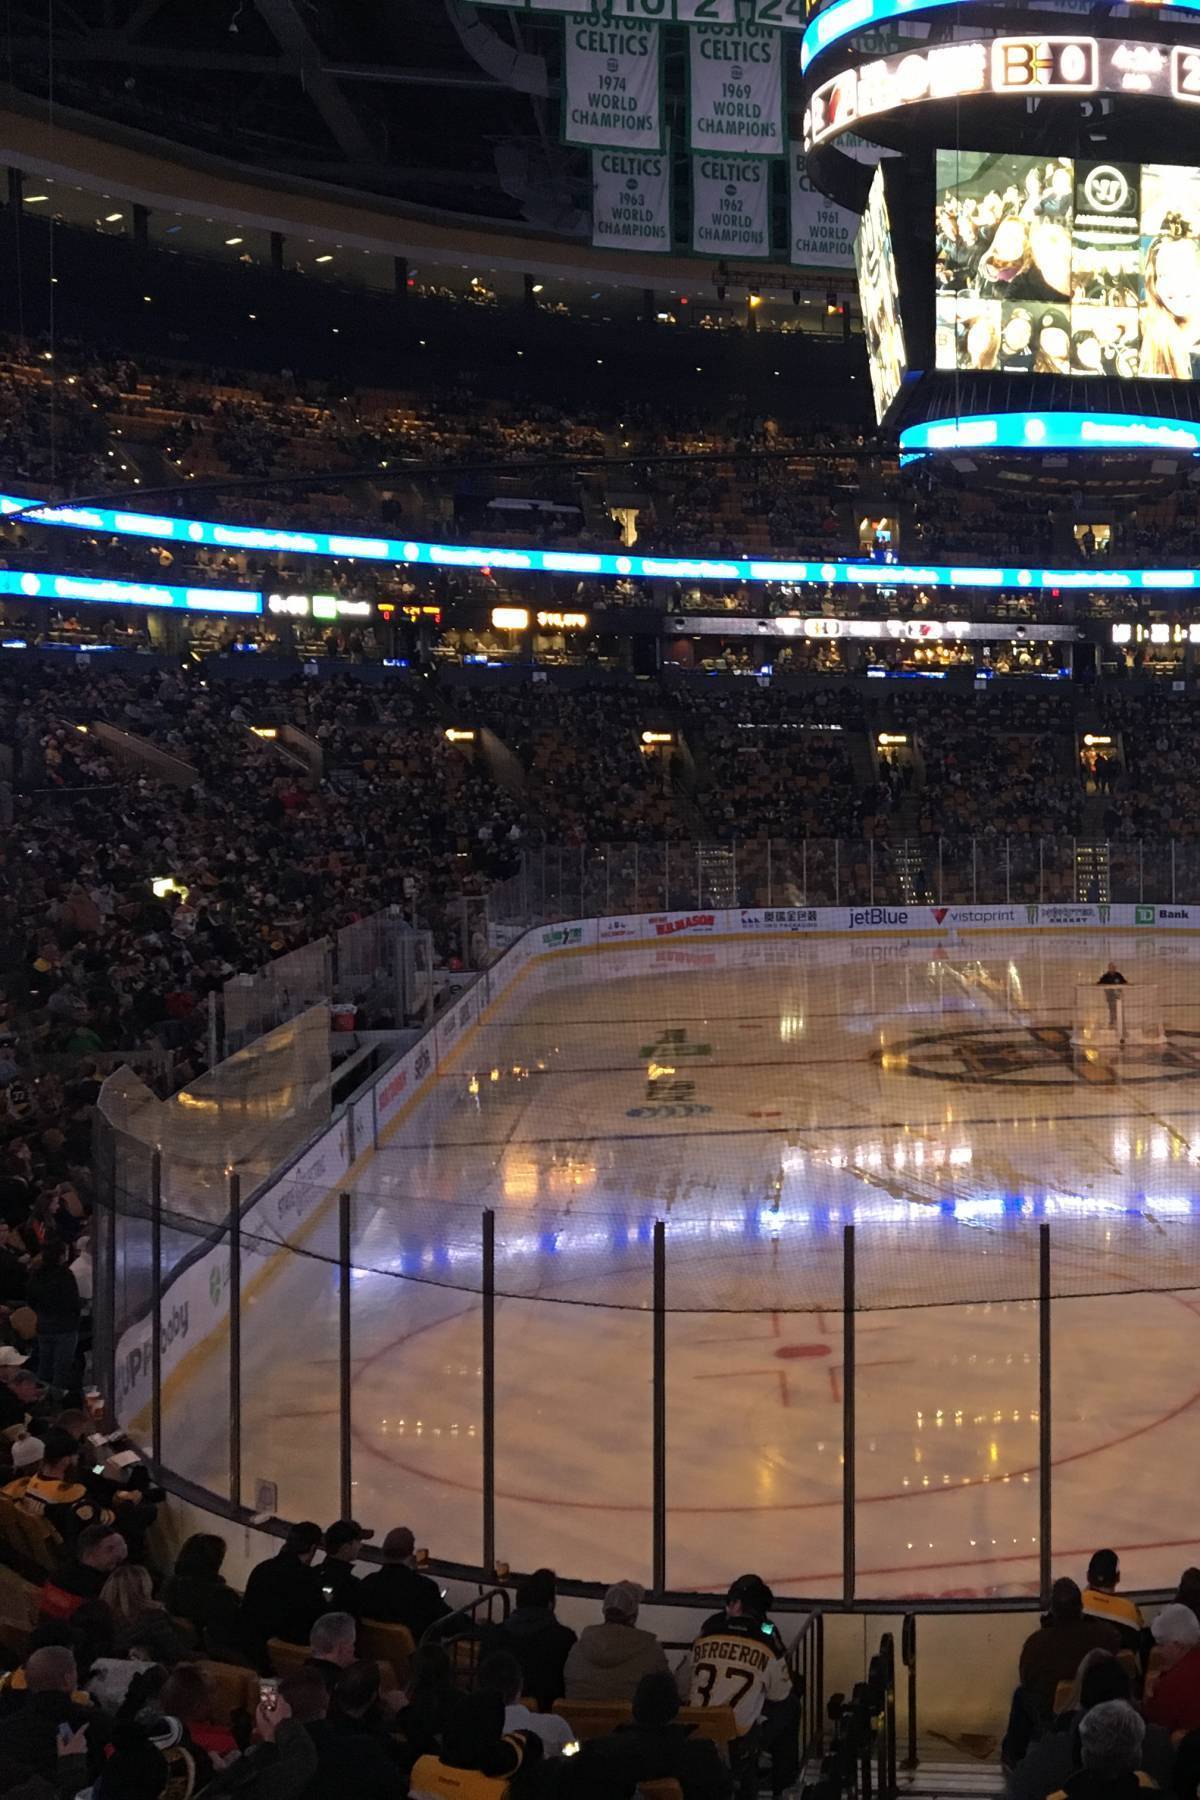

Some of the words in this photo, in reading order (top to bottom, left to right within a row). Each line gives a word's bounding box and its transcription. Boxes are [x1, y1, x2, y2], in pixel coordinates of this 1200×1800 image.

[575, 29, 649, 57] CELTICS
[700, 38, 771, 63] CELTICS
[1060, 44, 1086, 81] 0
[598, 75, 626, 92] 1974
[722, 83, 751, 99] 1969
[587, 93, 638, 111] WORLD
[713, 101, 761, 119] WORLD
[572, 109, 653, 131] CHAMPIONS
[697, 117, 776, 137] CHAMPIONS
[601, 155, 662, 177] CELTICS
[701, 161, 760, 182] CELTICS
[619, 191, 645, 207] 1963
[719, 198, 743, 212] 1962
[612, 207, 653, 222] WORLD
[712, 213, 752, 228] WORLD
[817, 211, 839, 224] 1961
[598, 221, 666, 239] CHAMPIONS
[700, 226, 763, 244] CHAMPIONS
[809, 226, 848, 240] WORLD
[796, 239, 855, 255] CHAMPION
[849, 908, 908, 928] jetBlue
[951, 909, 1015, 923] vistaprint
[1137, 909, 1154, 922] TD
[1159, 910, 1189, 919] Bank
[694, 1640, 770, 1672] BERGERON
[695, 1662, 754, 1707] 37
